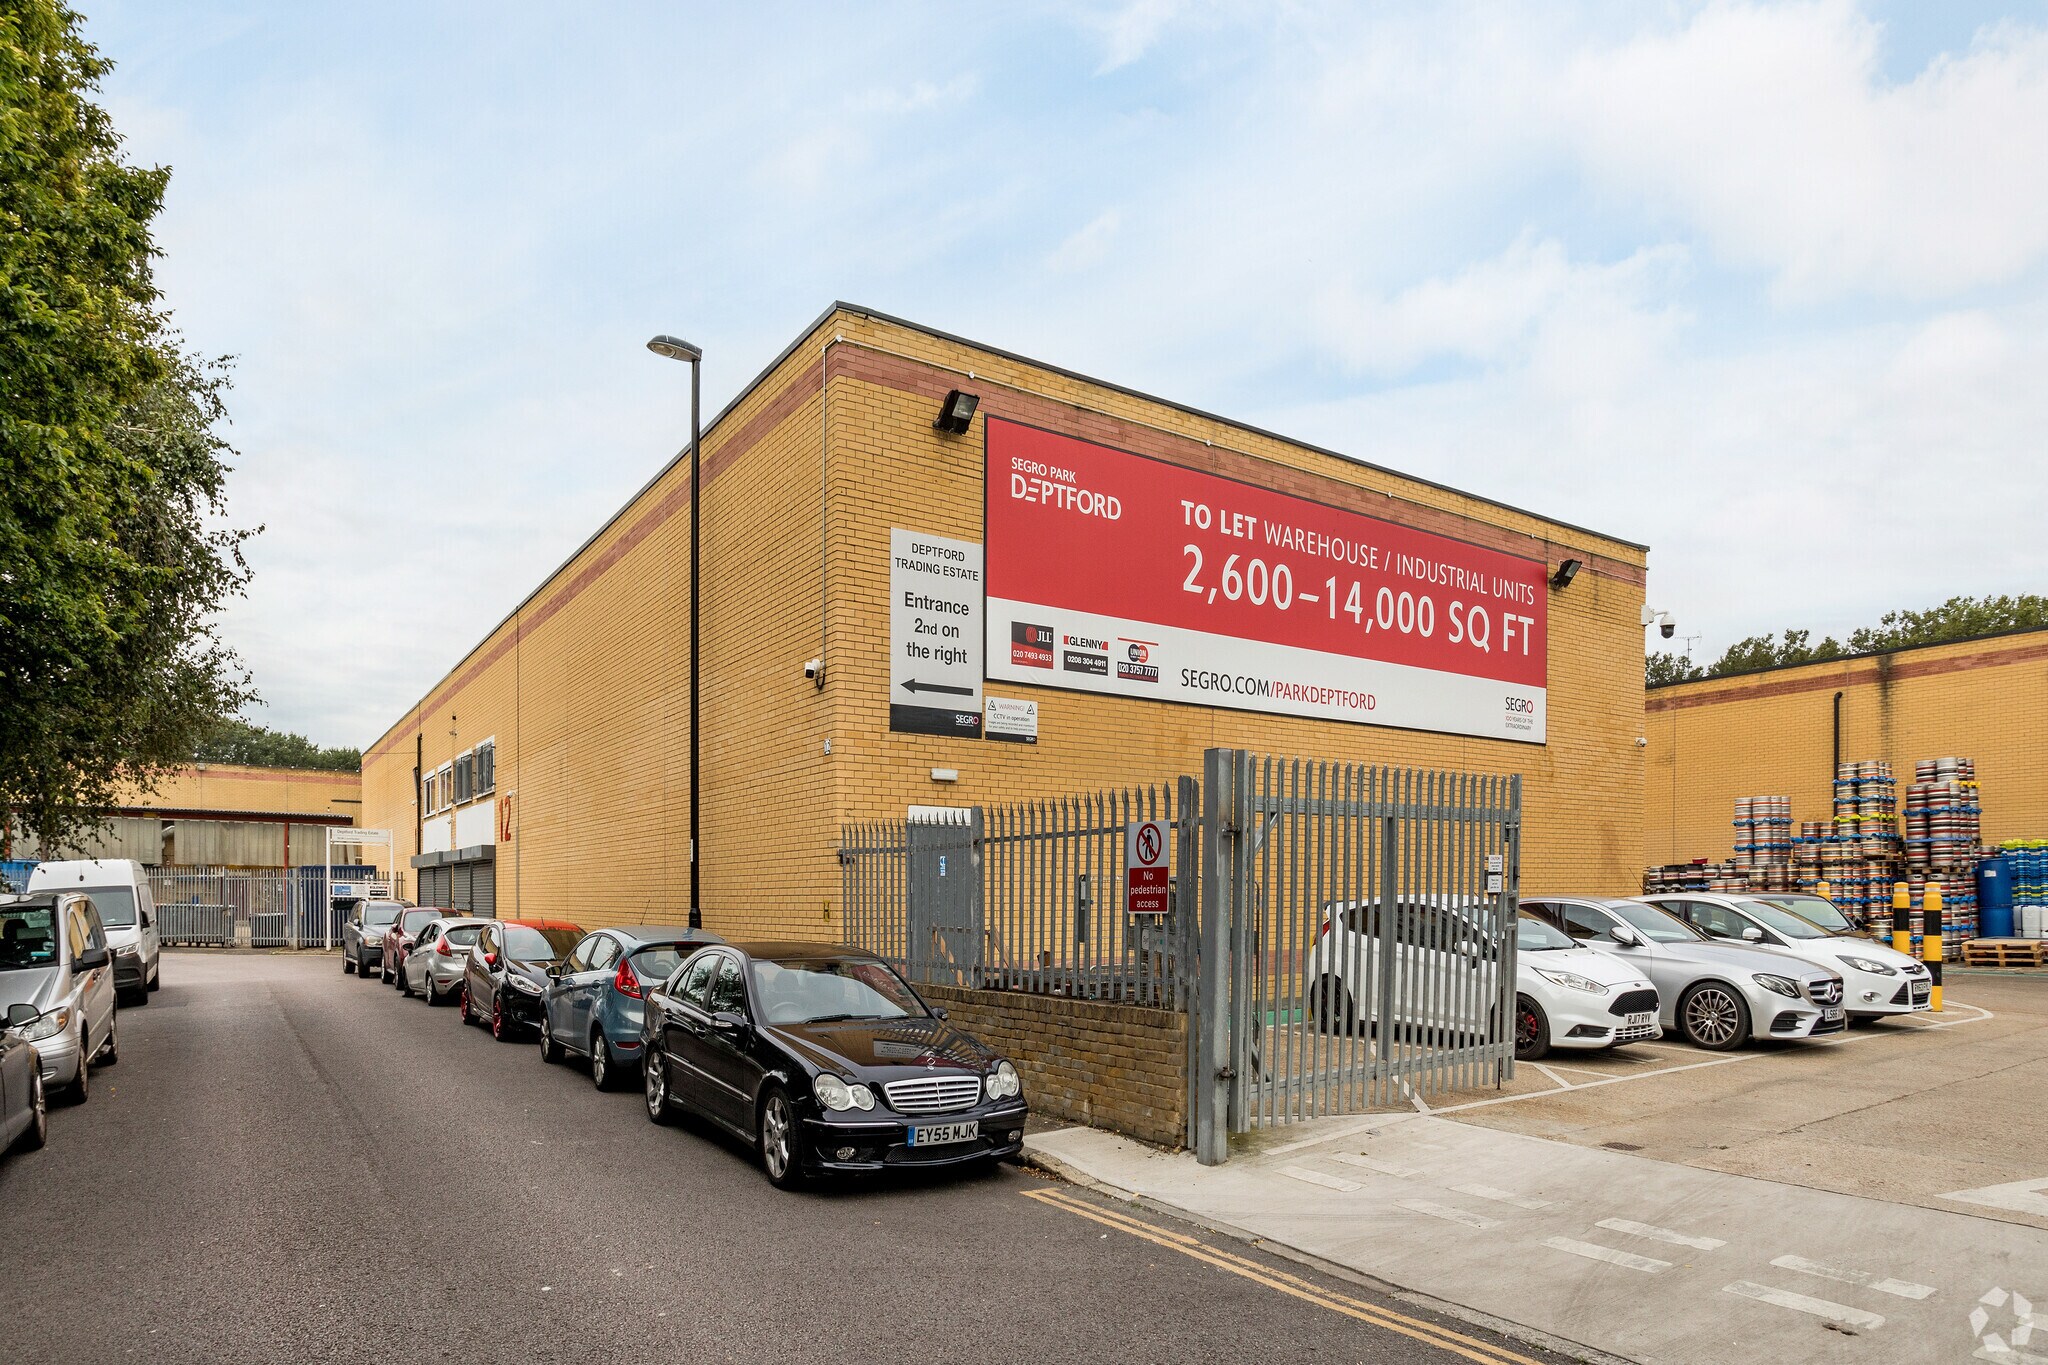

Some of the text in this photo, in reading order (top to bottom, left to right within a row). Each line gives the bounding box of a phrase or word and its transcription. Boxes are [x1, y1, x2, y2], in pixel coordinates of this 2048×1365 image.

[1011, 456, 1077, 484] SEGRO PARK
[1011, 473, 1122, 520] DEPTFORD
[911, 542, 965, 562] DEPTFORD
[1180, 499, 1212, 530] TO
[1220, 509, 1257, 540] LET
[1264, 520, 1379, 570] WAREHOUSE
[1396, 553, 1488, 595] INDUSTRIAL
[1493, 576, 1535, 606] UNITS
[894, 557, 979, 582] TRADING ESTATE
[904, 591, 970, 616] Entrance
[914, 617, 960, 639] 2nd on
[1448, 600, 1490, 654] SQ
[1503, 611, 1535, 656] FT
[906, 641, 968, 666] the right
[1069, 636, 1103, 650] GLENNY
[1130, 648, 1146, 657] UNION
[1012, 649, 1023, 658] 020
[1024, 651, 1038, 660] 7493
[1038, 653, 1052, 662] 4933
[1118, 663, 1129, 673] 020
[1181, 668, 1376, 711] SEGRO.COM/PARKDEPTFORD
[1505, 696, 1534, 714] SEGRO
[955, 714, 979, 725] SEGRO
[498, 795, 512, 842] 12
[1143, 870, 1154, 881] No
[1130, 884, 1166, 896] pedestrian
[1136, 900, 1159, 908] access
[916, 1122, 977, 1143] EY55 MJK
